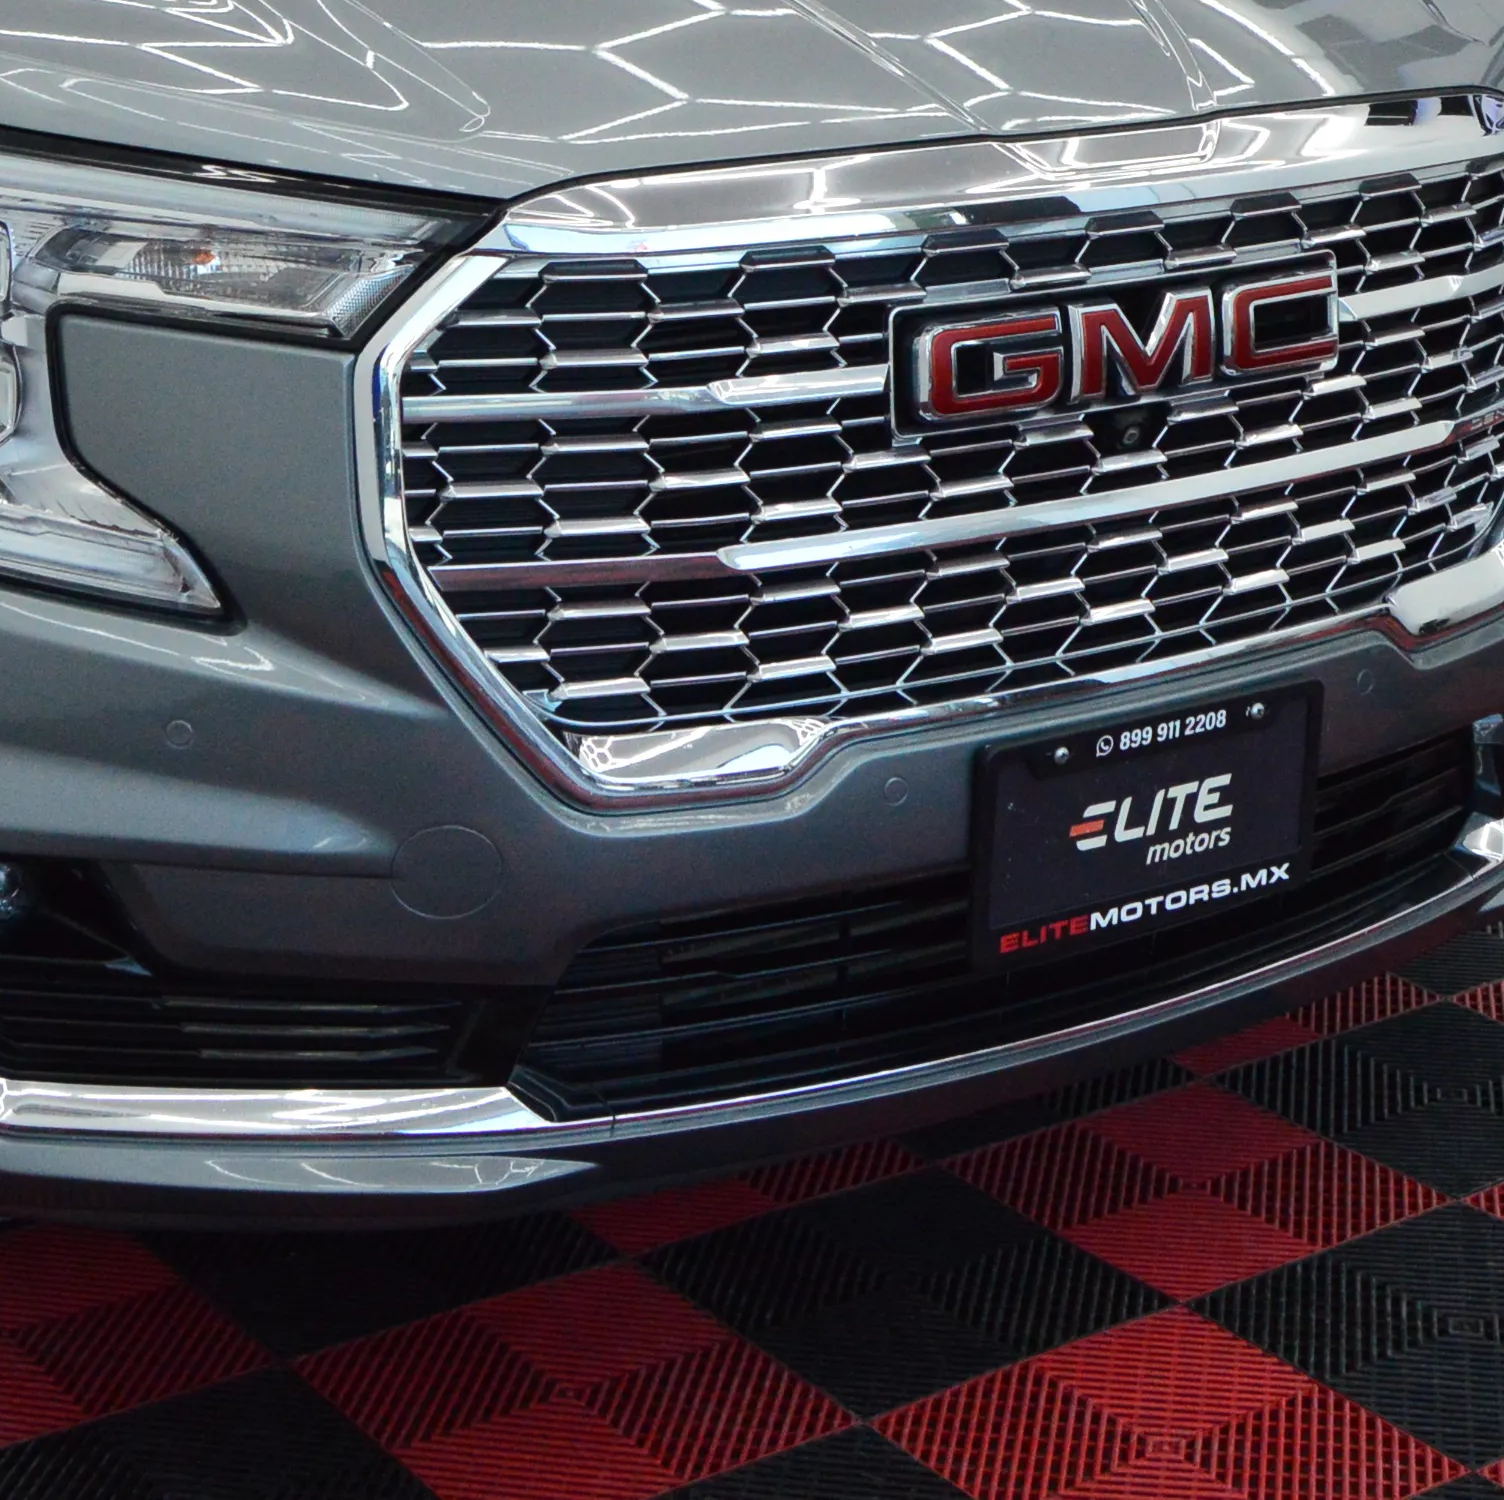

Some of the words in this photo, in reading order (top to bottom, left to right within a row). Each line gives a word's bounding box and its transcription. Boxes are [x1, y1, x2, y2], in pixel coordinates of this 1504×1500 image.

[915, 265, 1338, 421] GMC
[1119, 727, 1152, 751] 899
[1157, 719, 1181, 742] 911
[1185, 709, 1227, 736] 2208
[1069, 773, 1233, 851] ELITE
[1146, 826, 1231, 866] motors
[999, 862, 1290, 954] ELITEMOTORS.MX
